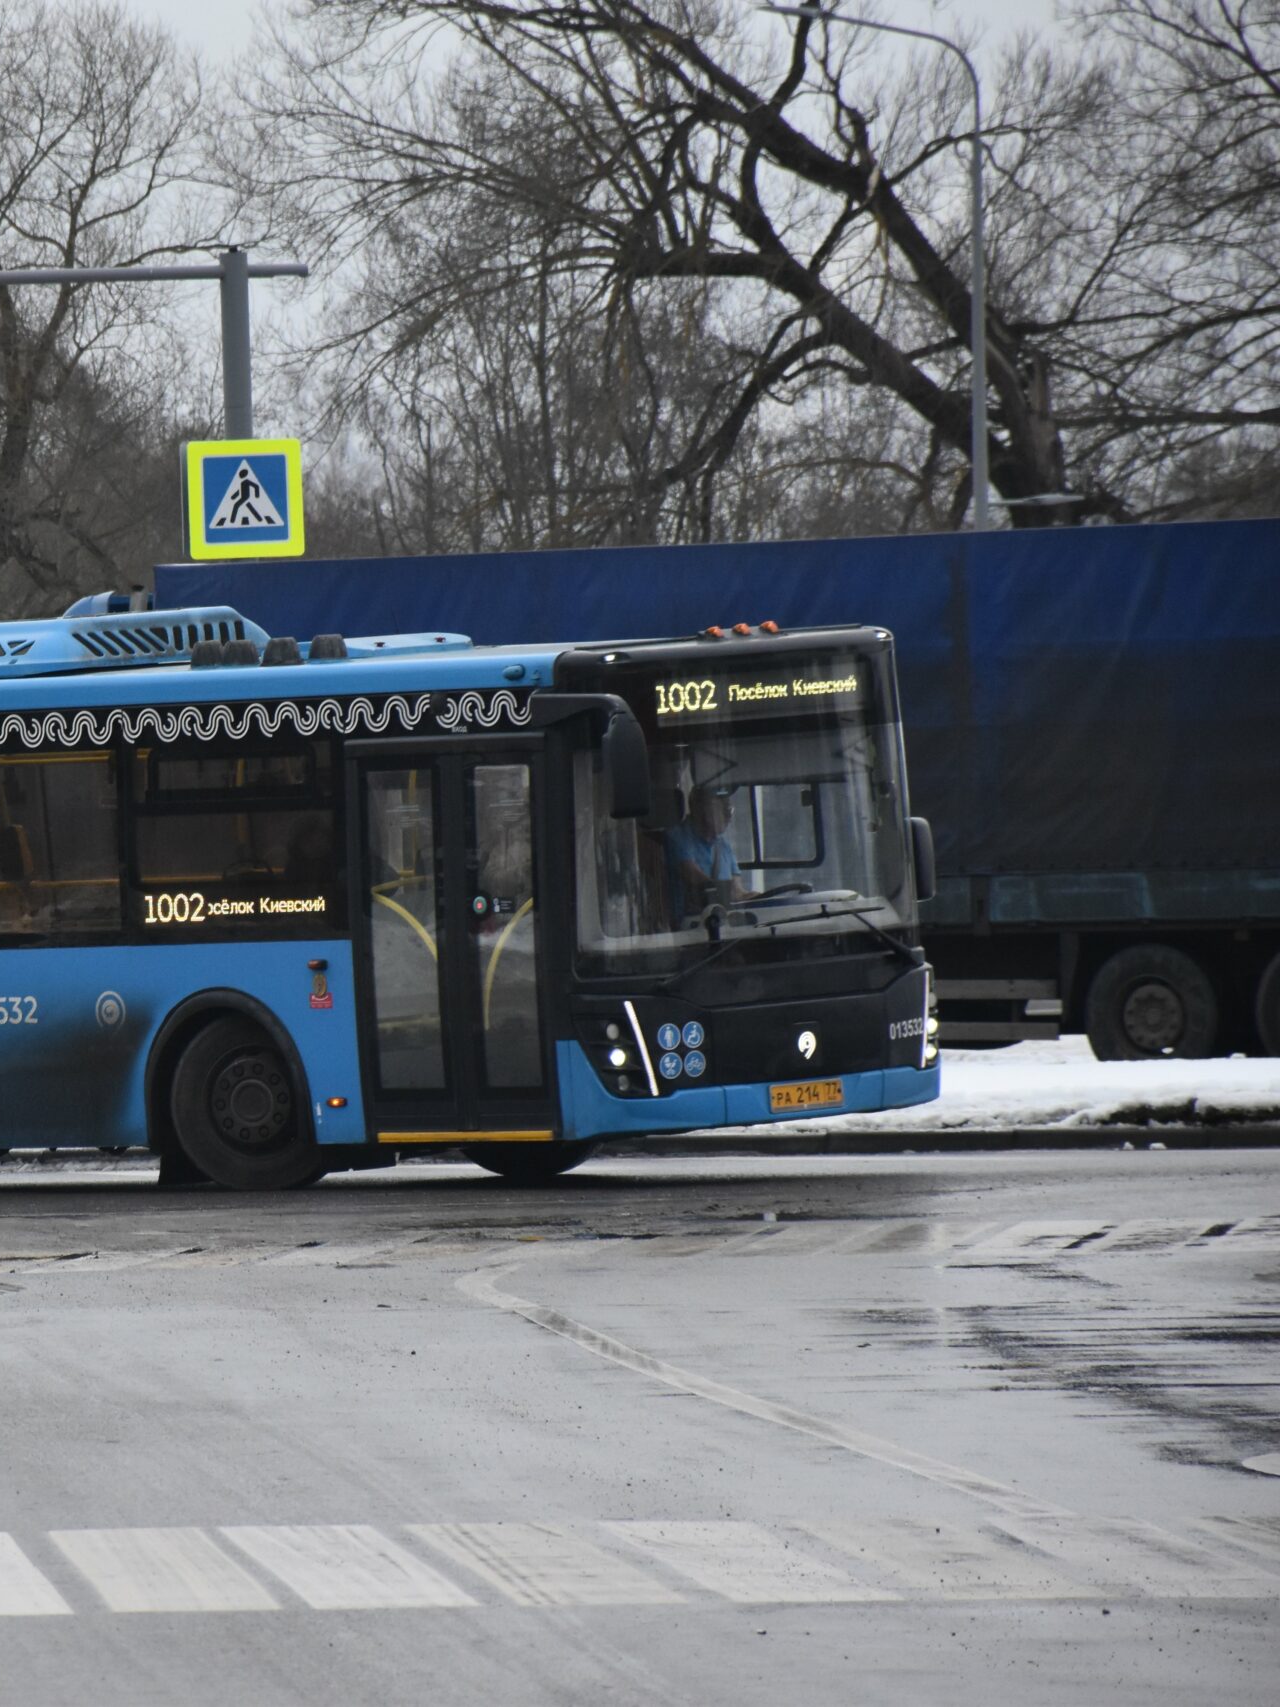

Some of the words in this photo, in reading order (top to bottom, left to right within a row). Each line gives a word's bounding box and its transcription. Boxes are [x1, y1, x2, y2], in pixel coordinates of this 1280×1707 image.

[655, 680, 717, 714] 1002
[728, 683, 788, 701] Посёлок
[793, 675, 857, 696] Киевский
[145, 893, 205, 923] 1002
[260, 896, 326, 913] Киевский
[889, 1017, 924, 1040] 013532
[796, 1085, 820, 1103] 214
